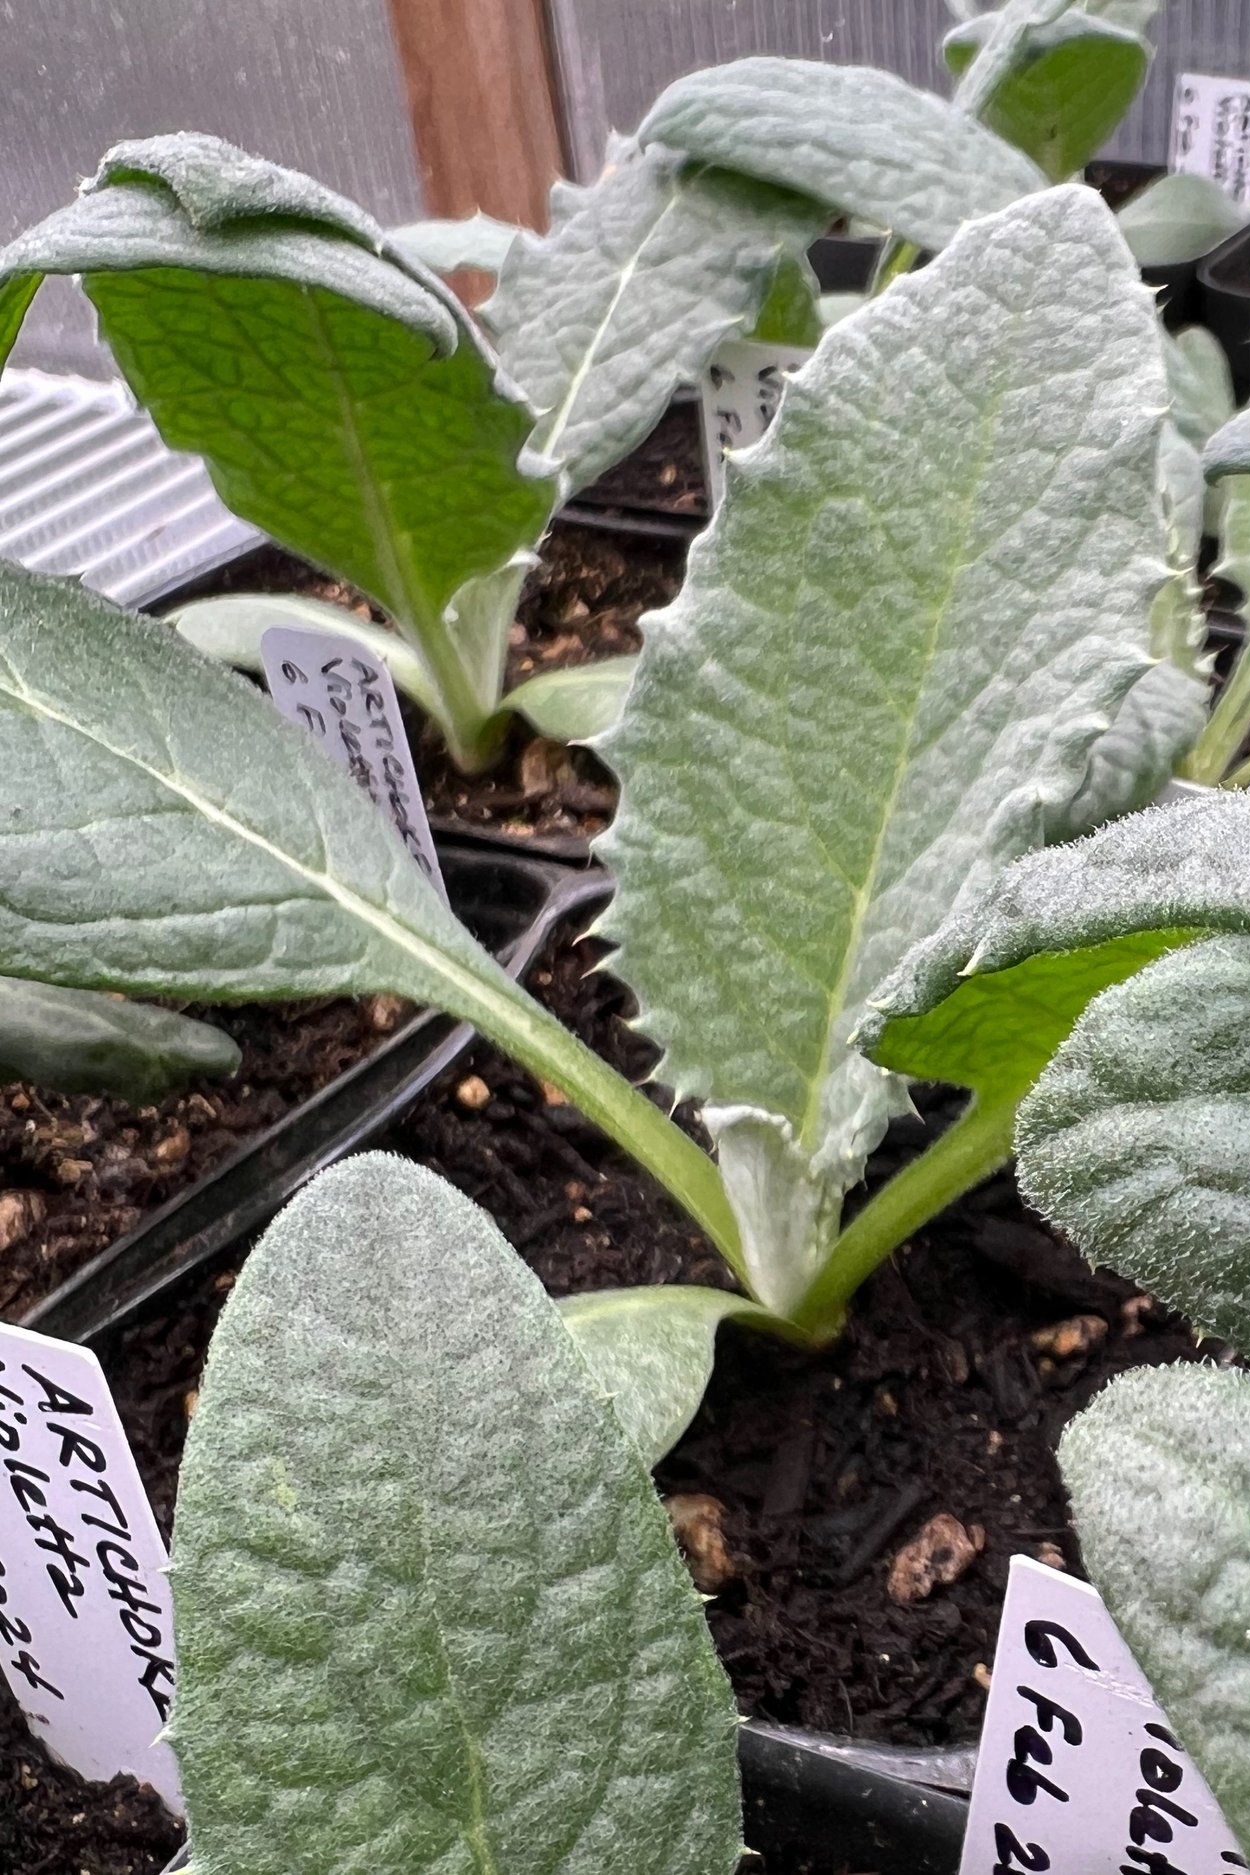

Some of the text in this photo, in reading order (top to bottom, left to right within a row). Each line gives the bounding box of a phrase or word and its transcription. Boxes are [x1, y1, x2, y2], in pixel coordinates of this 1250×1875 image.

[281, 659, 309, 685] 6
[1024, 1619, 1101, 1672] 6
[1006, 1685, 1084, 1806] Feb
